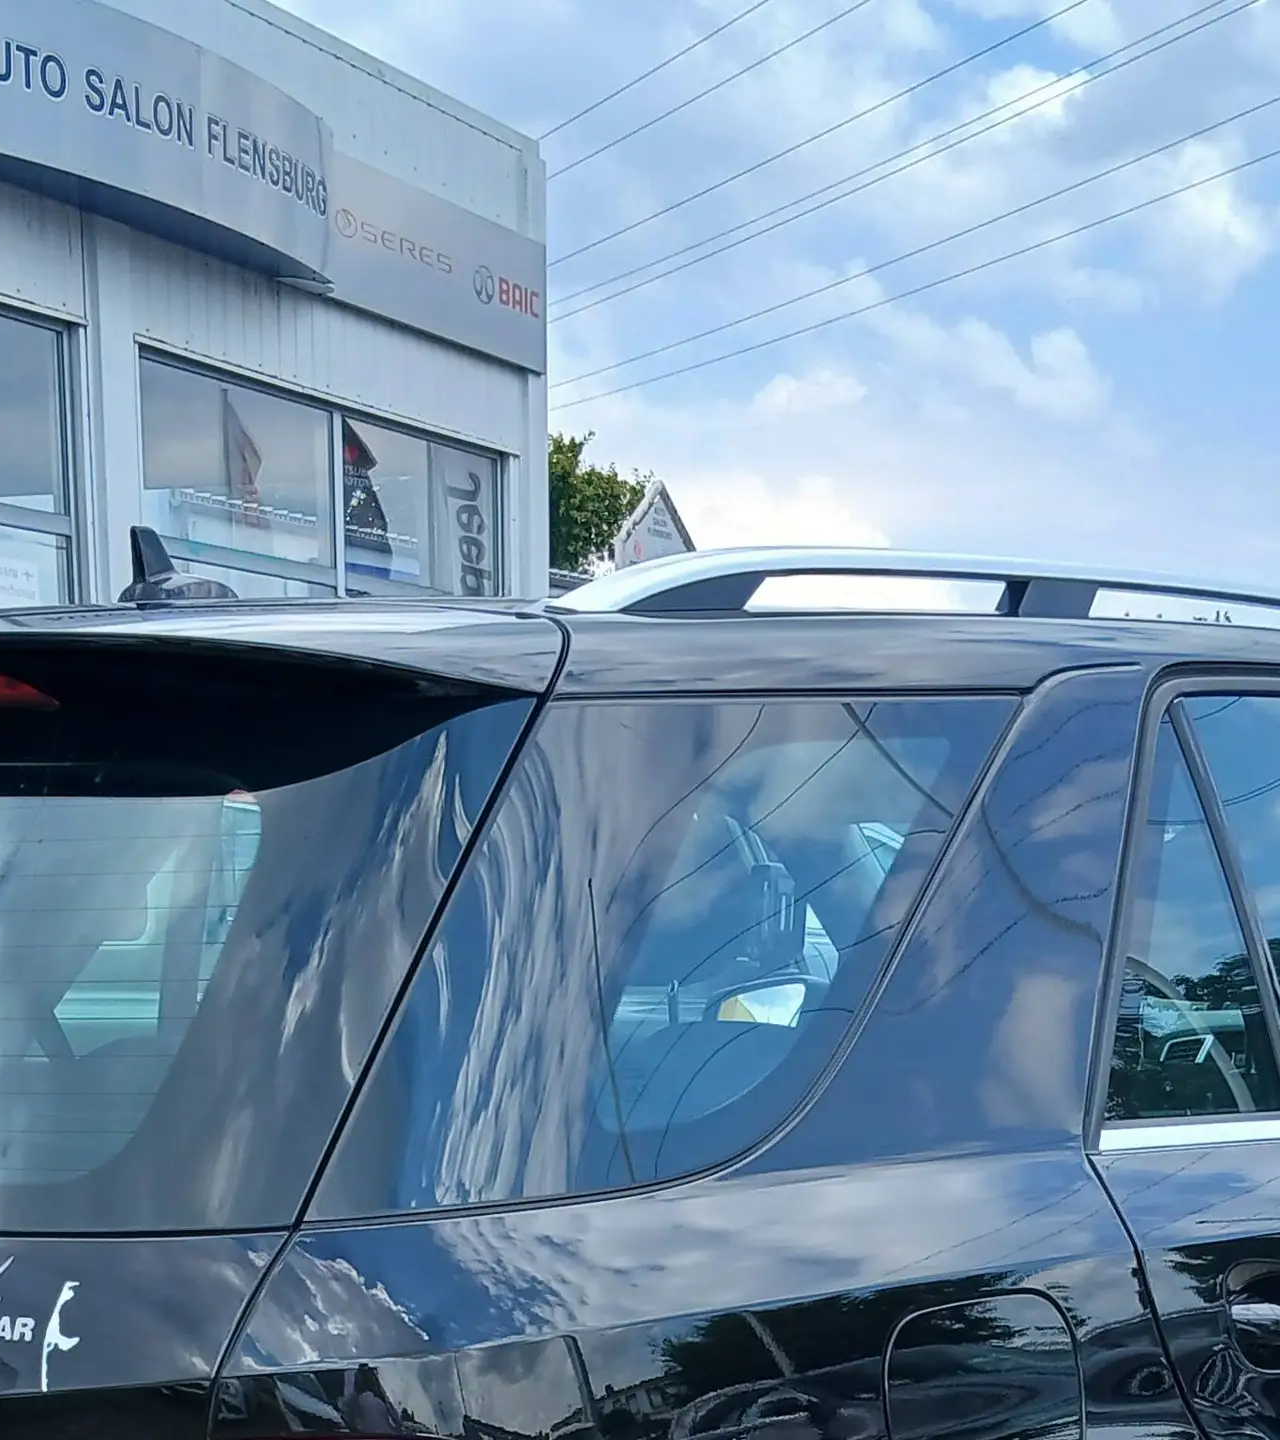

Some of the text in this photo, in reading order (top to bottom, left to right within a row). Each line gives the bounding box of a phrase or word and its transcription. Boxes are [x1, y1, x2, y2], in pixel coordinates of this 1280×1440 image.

[82, 65, 196, 150] SALON
[206, 112, 329, 220] FLENSBURG
[360, 221, 452, 274] SERES
[498, 276, 540, 319] BAIC
